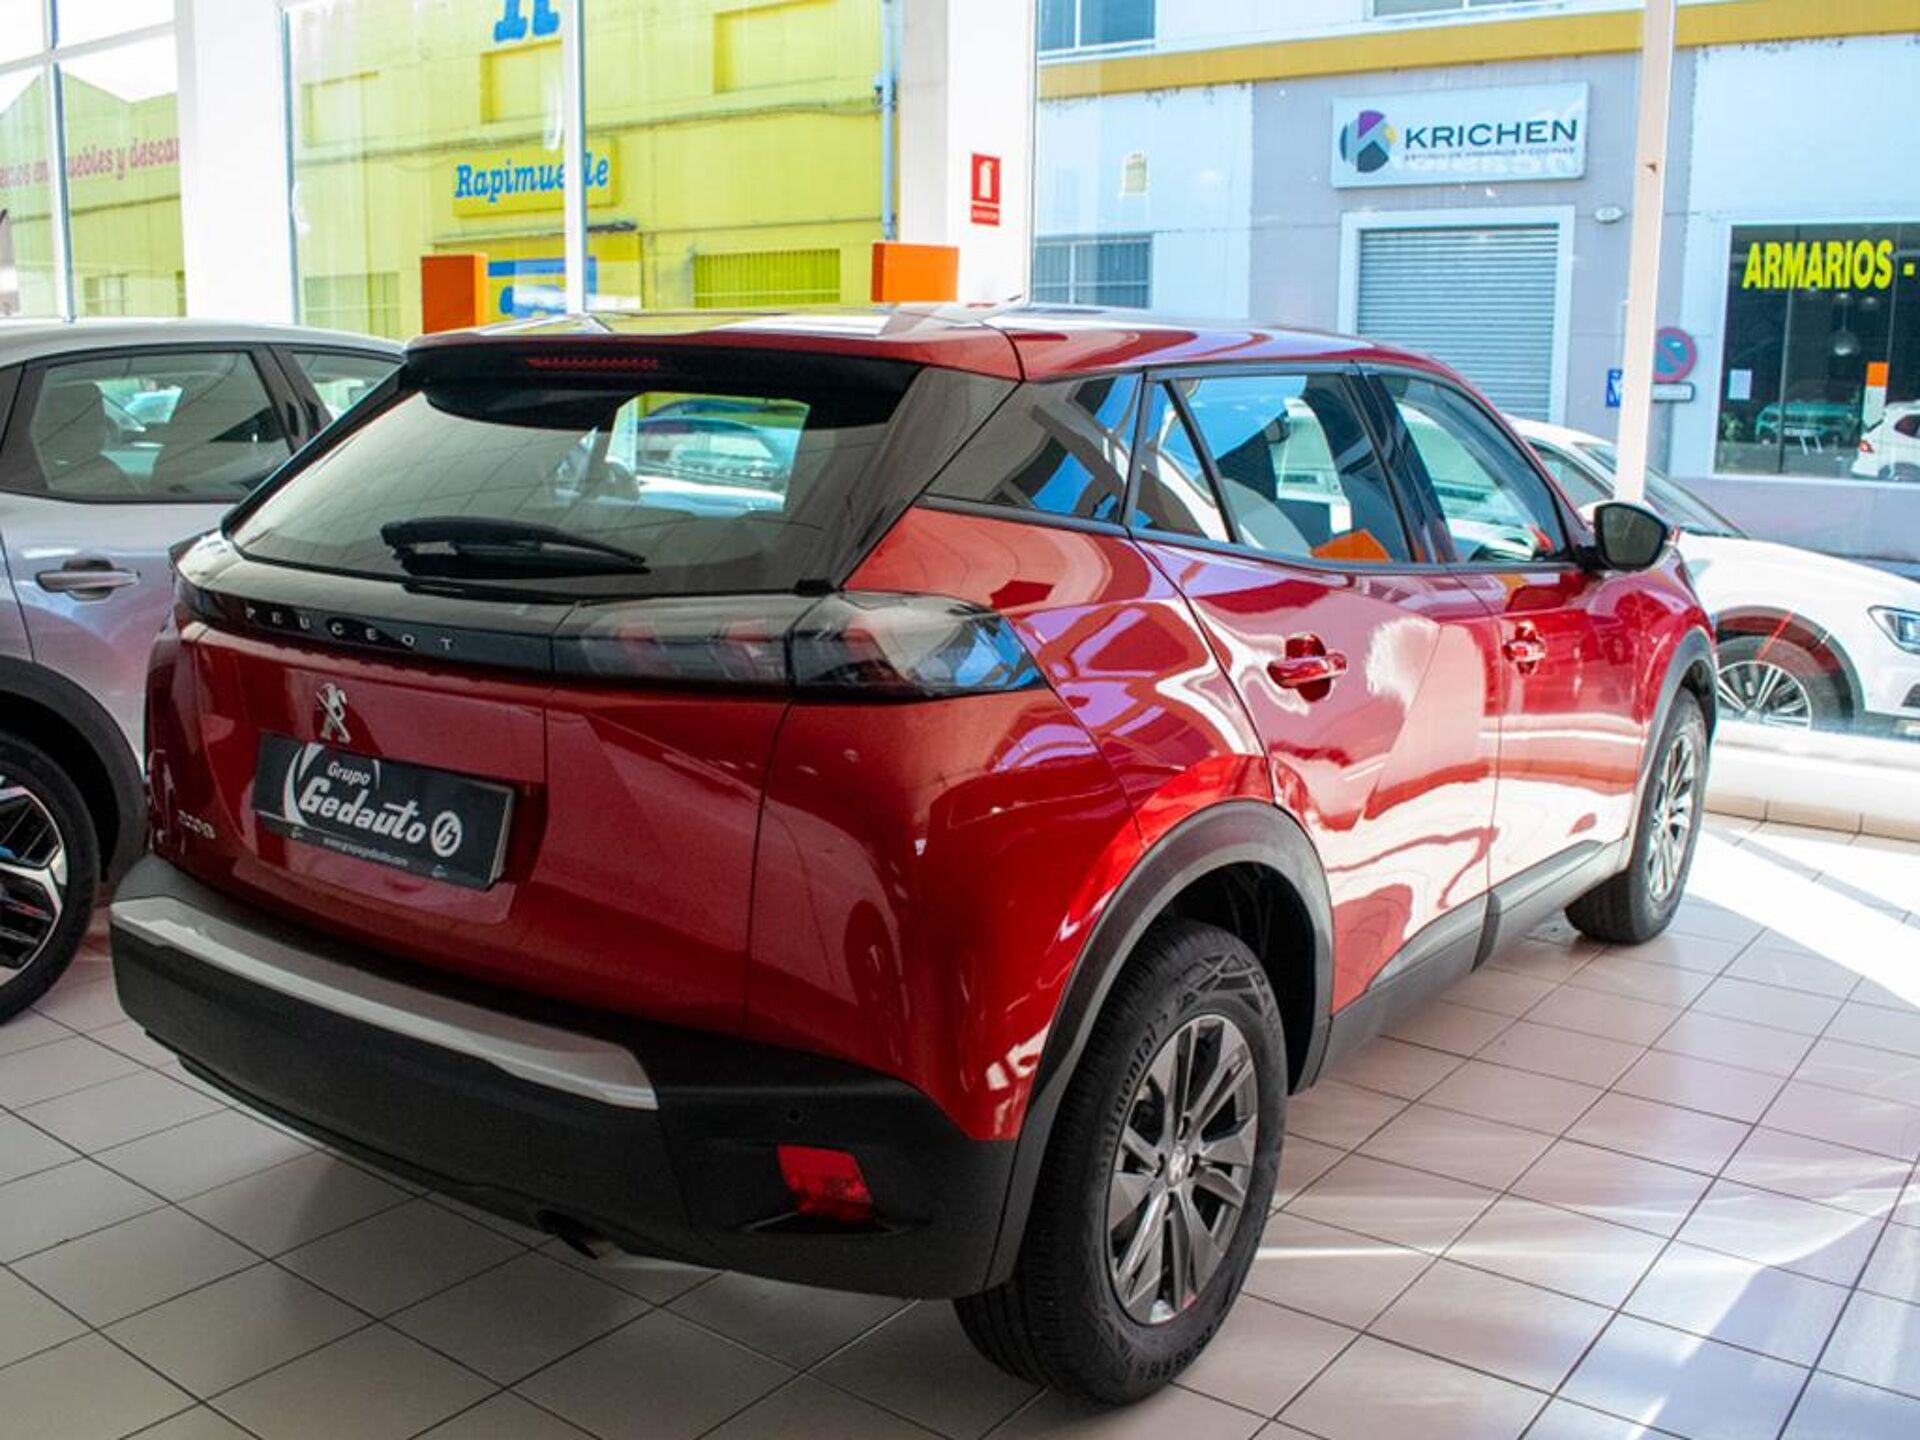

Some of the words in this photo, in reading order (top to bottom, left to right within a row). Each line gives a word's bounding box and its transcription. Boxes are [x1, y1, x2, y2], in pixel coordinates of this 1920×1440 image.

[1404, 119, 1577, 150] KRICHEN
[454, 151, 608, 203] Rapimuele
[1742, 239, 1893, 289] ARMARIOS
[246, 606, 452, 651] PEUGEOT
[327, 761, 371, 785] Grupo
[299, 776, 427, 843] Gedauto
